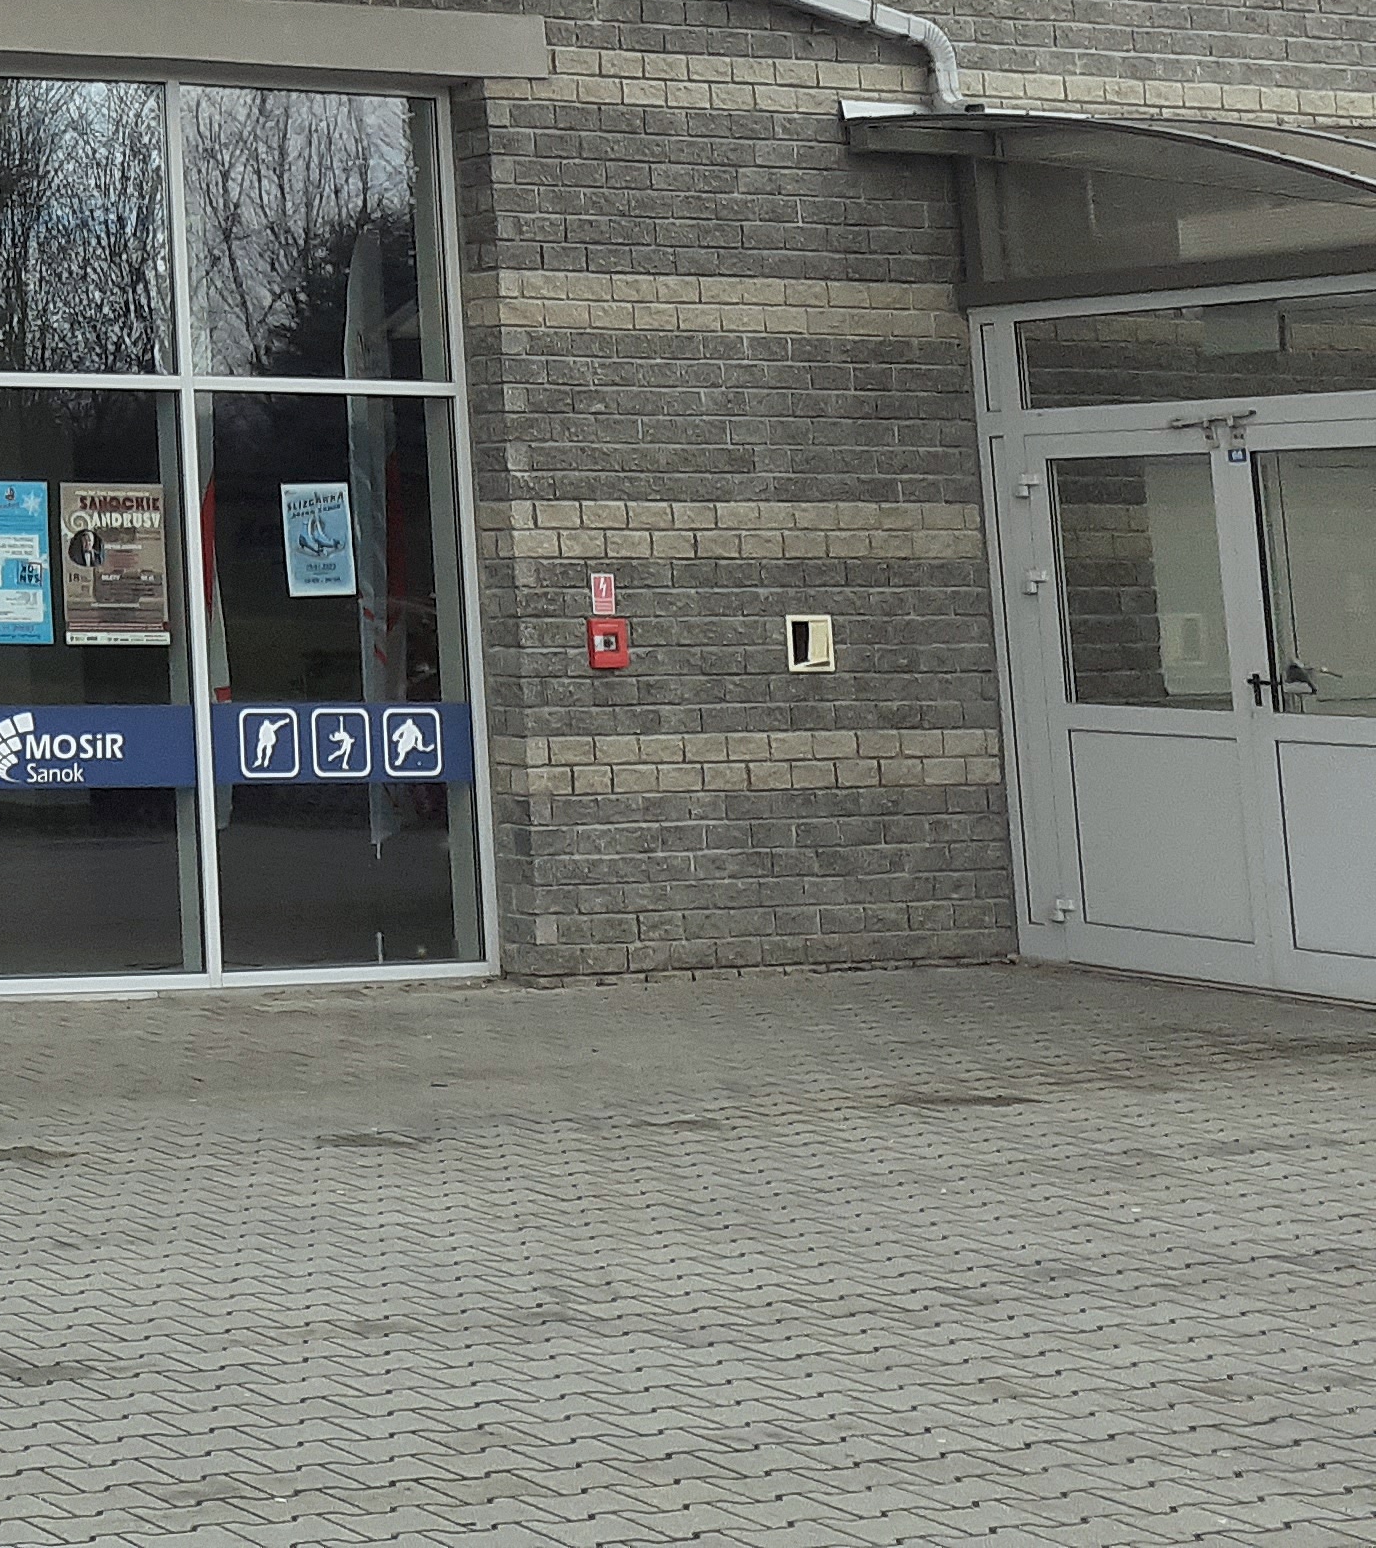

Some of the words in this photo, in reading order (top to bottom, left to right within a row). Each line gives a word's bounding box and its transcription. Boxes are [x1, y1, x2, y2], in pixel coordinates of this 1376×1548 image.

[79, 495, 160, 512] SANOCKIE
[25, 733, 124, 760] MOSiR
[26, 762, 85, 784] Sanok
